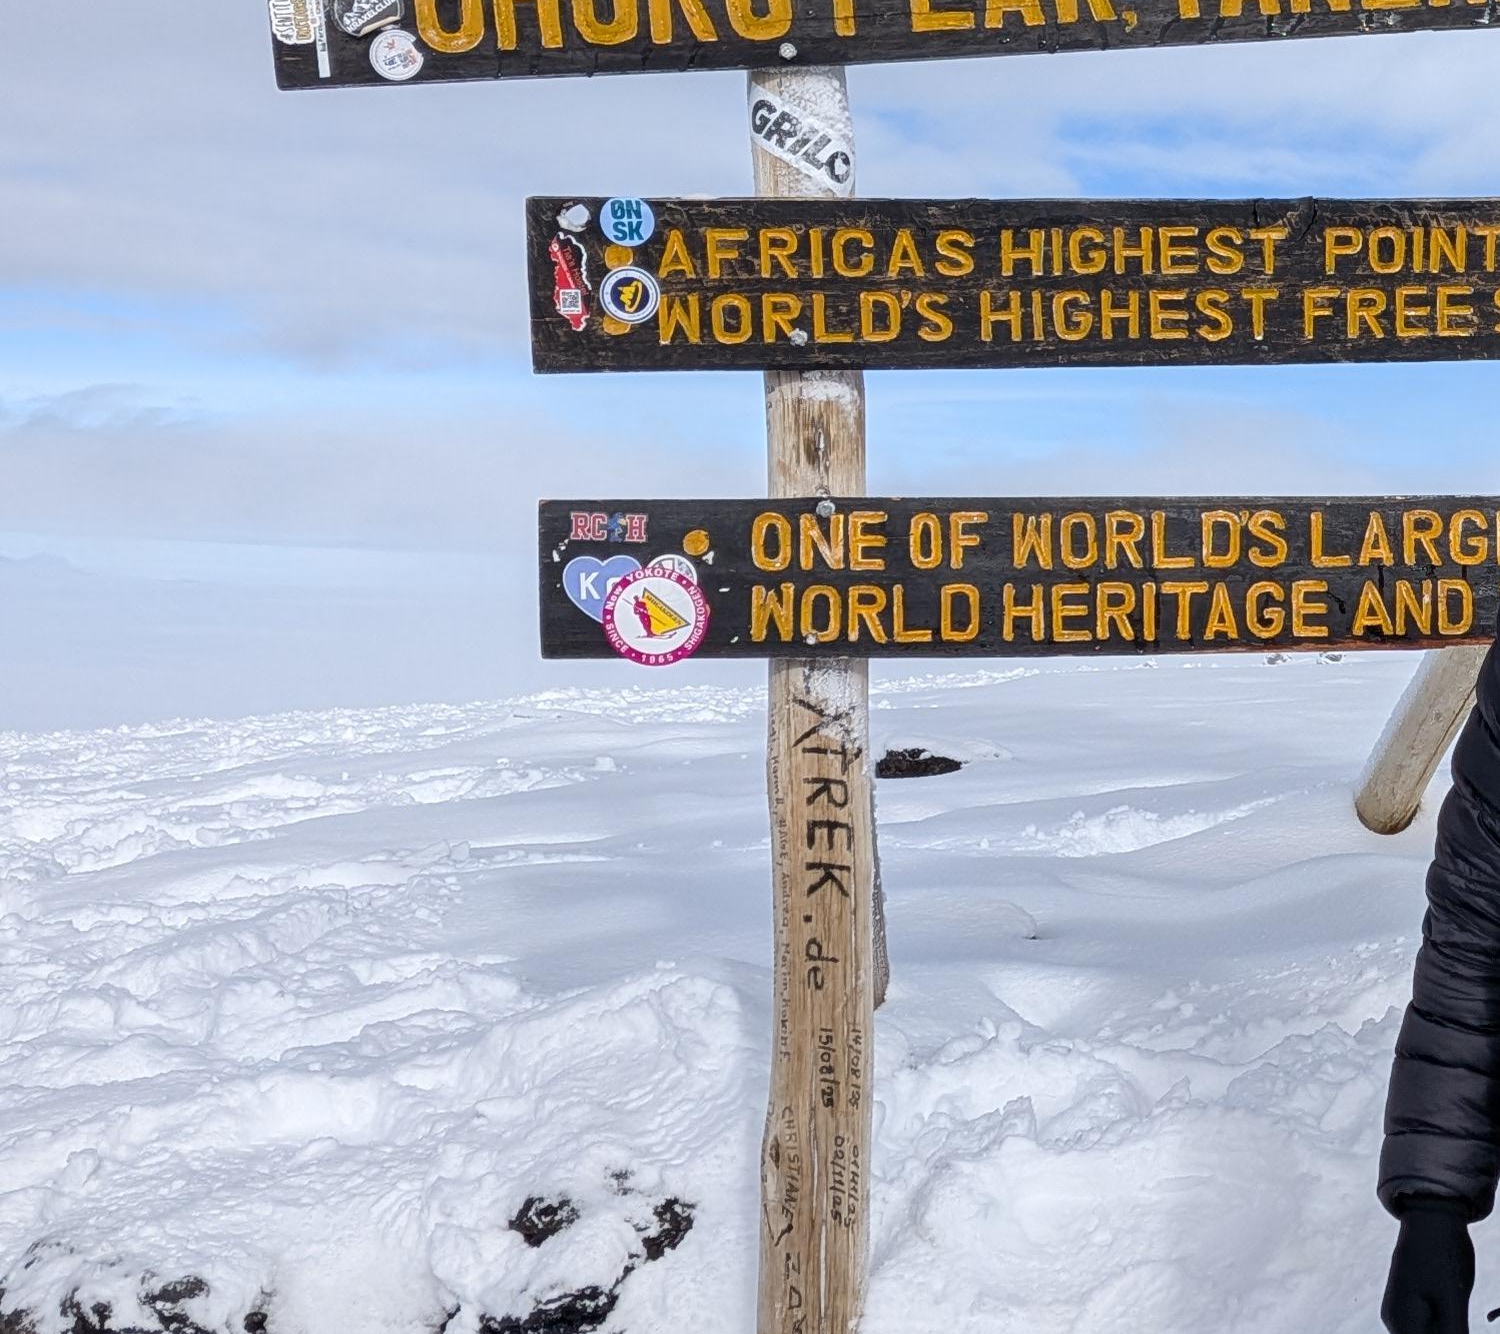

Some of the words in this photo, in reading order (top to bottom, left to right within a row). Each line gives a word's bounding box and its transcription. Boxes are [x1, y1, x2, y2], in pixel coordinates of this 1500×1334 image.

[612, 220, 645, 242] SK
[1002, 226, 1289, 277] HIGHEST
[658, 289, 953, 346] WORLD'S
[980, 284, 1280, 342] HIGHEST
[1303, 285, 1475, 340] FREE
[751, 510, 888, 571] ONE
[909, 511, 989, 570] OF
[1012, 509, 1289, 569] WORLD'S
[626, 568, 680, 583] YOKOTE
[684, 586, 707, 652] SHIGAKOGEN
[750, 582, 981, 644] WORLD
[1002, 578, 1329, 643] HERITAGE
[1351, 577, 1474, 638] AND
[605, 623, 628, 654] SINCE
[640, 652, 674, 664] 1965
